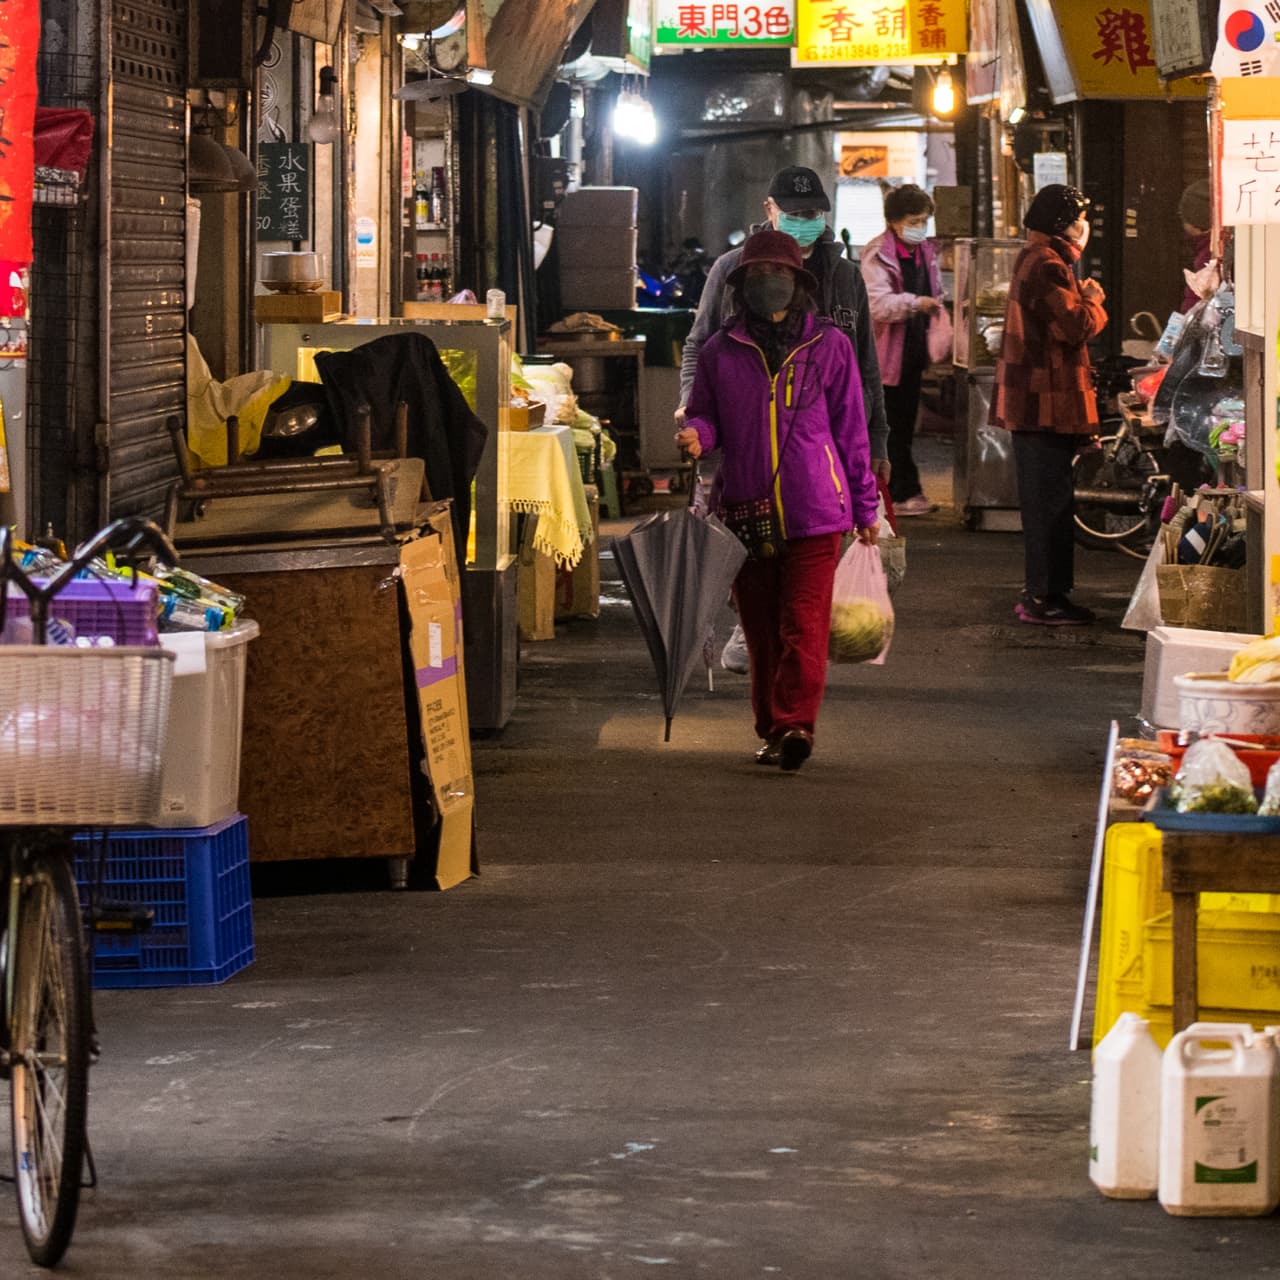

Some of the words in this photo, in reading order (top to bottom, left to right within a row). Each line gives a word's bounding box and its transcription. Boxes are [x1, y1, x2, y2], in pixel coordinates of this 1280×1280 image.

[677, 3, 791, 38] 東門3色
[277, 148, 307, 239] 水果蛋糕
